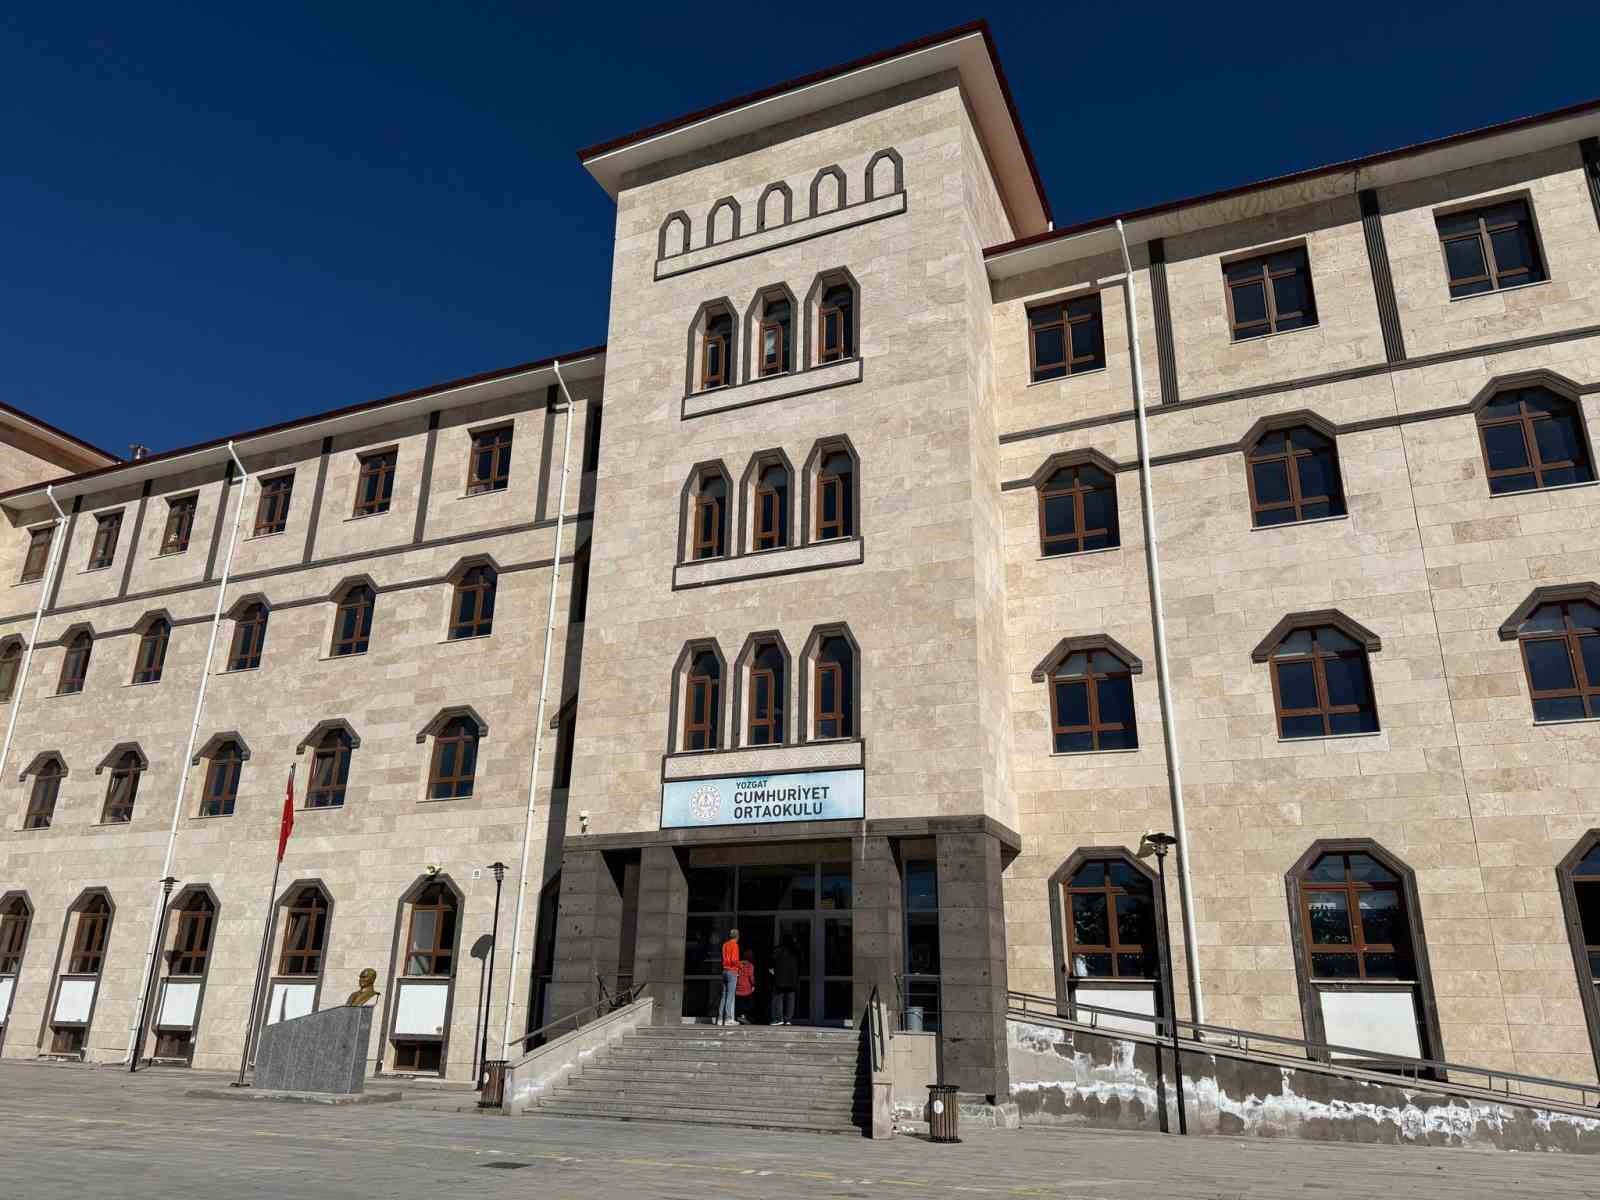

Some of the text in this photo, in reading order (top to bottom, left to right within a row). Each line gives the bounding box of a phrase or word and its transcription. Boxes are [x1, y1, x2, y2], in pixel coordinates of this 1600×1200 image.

[736, 780, 768, 790] YOZGAT
[734, 785, 830, 803] CUMHURİYET
[734, 803, 823, 819] ORTAOKULU
